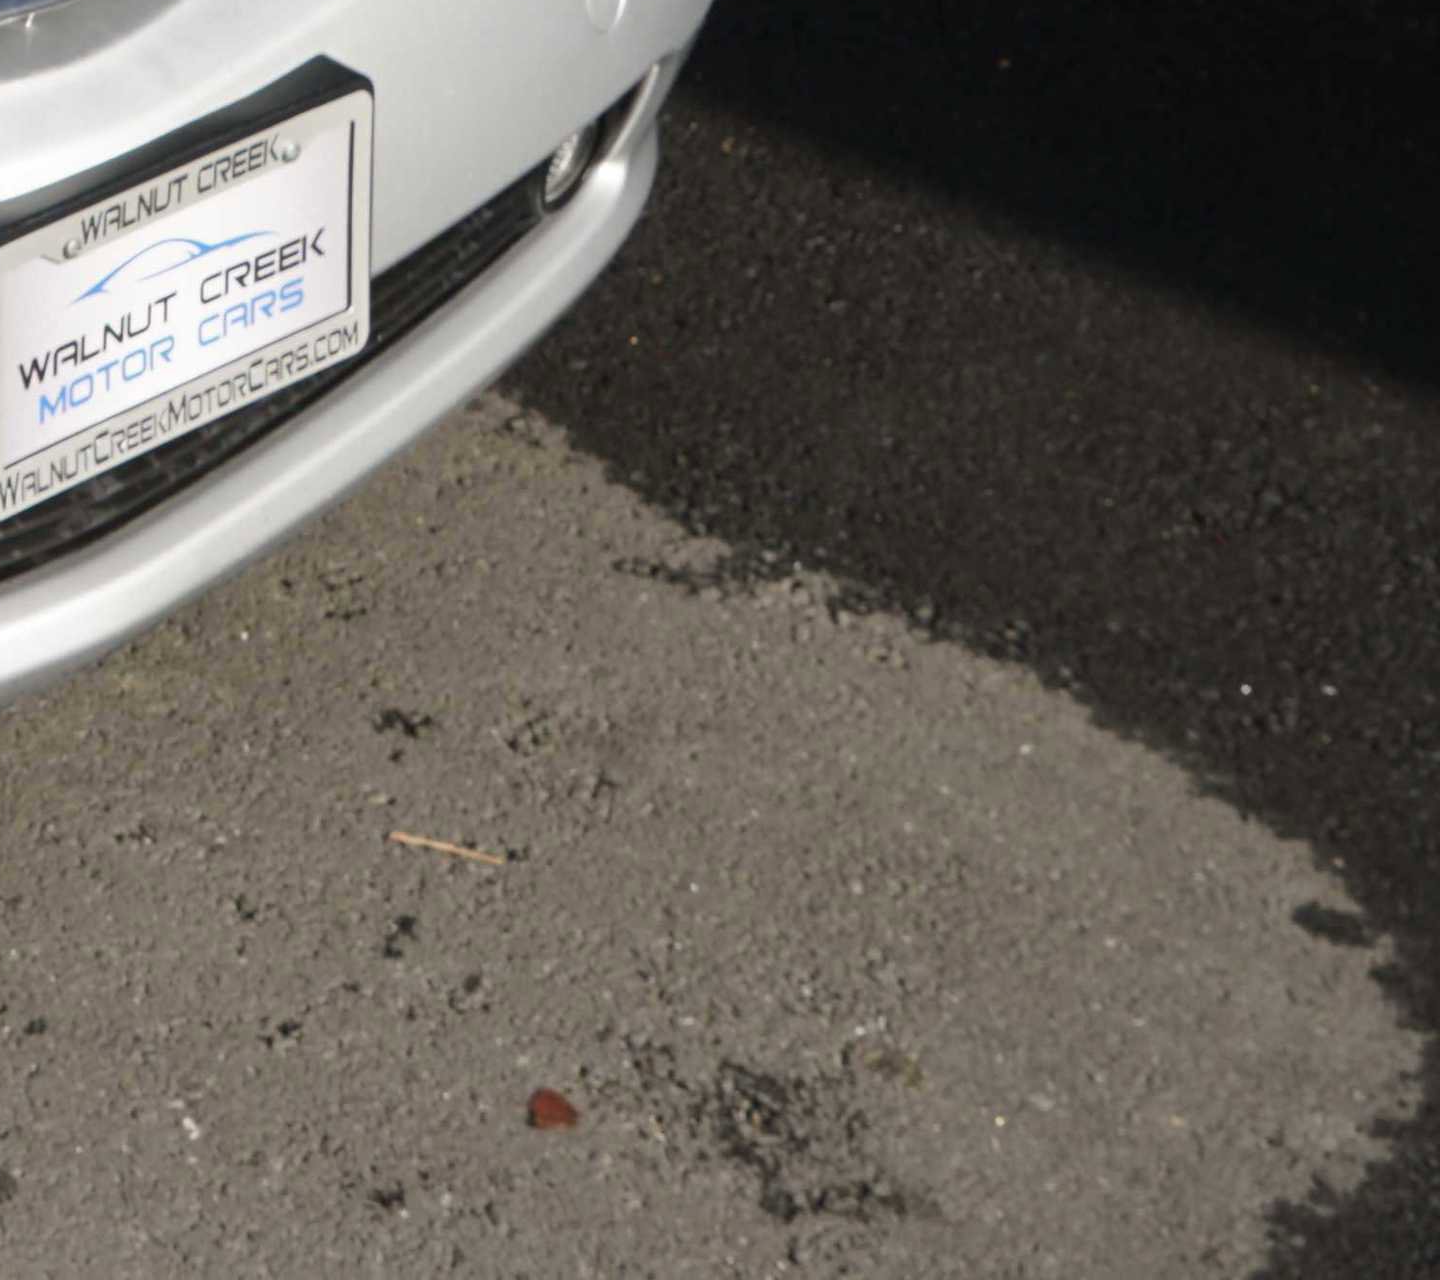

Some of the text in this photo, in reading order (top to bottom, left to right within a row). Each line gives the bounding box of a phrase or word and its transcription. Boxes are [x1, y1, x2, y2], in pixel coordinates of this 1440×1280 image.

[80, 134, 280, 243] WALNUT CREEK
[18, 226, 326, 391] WALNUT CREEK
[38, 276, 305, 425] MOTOR CARS
